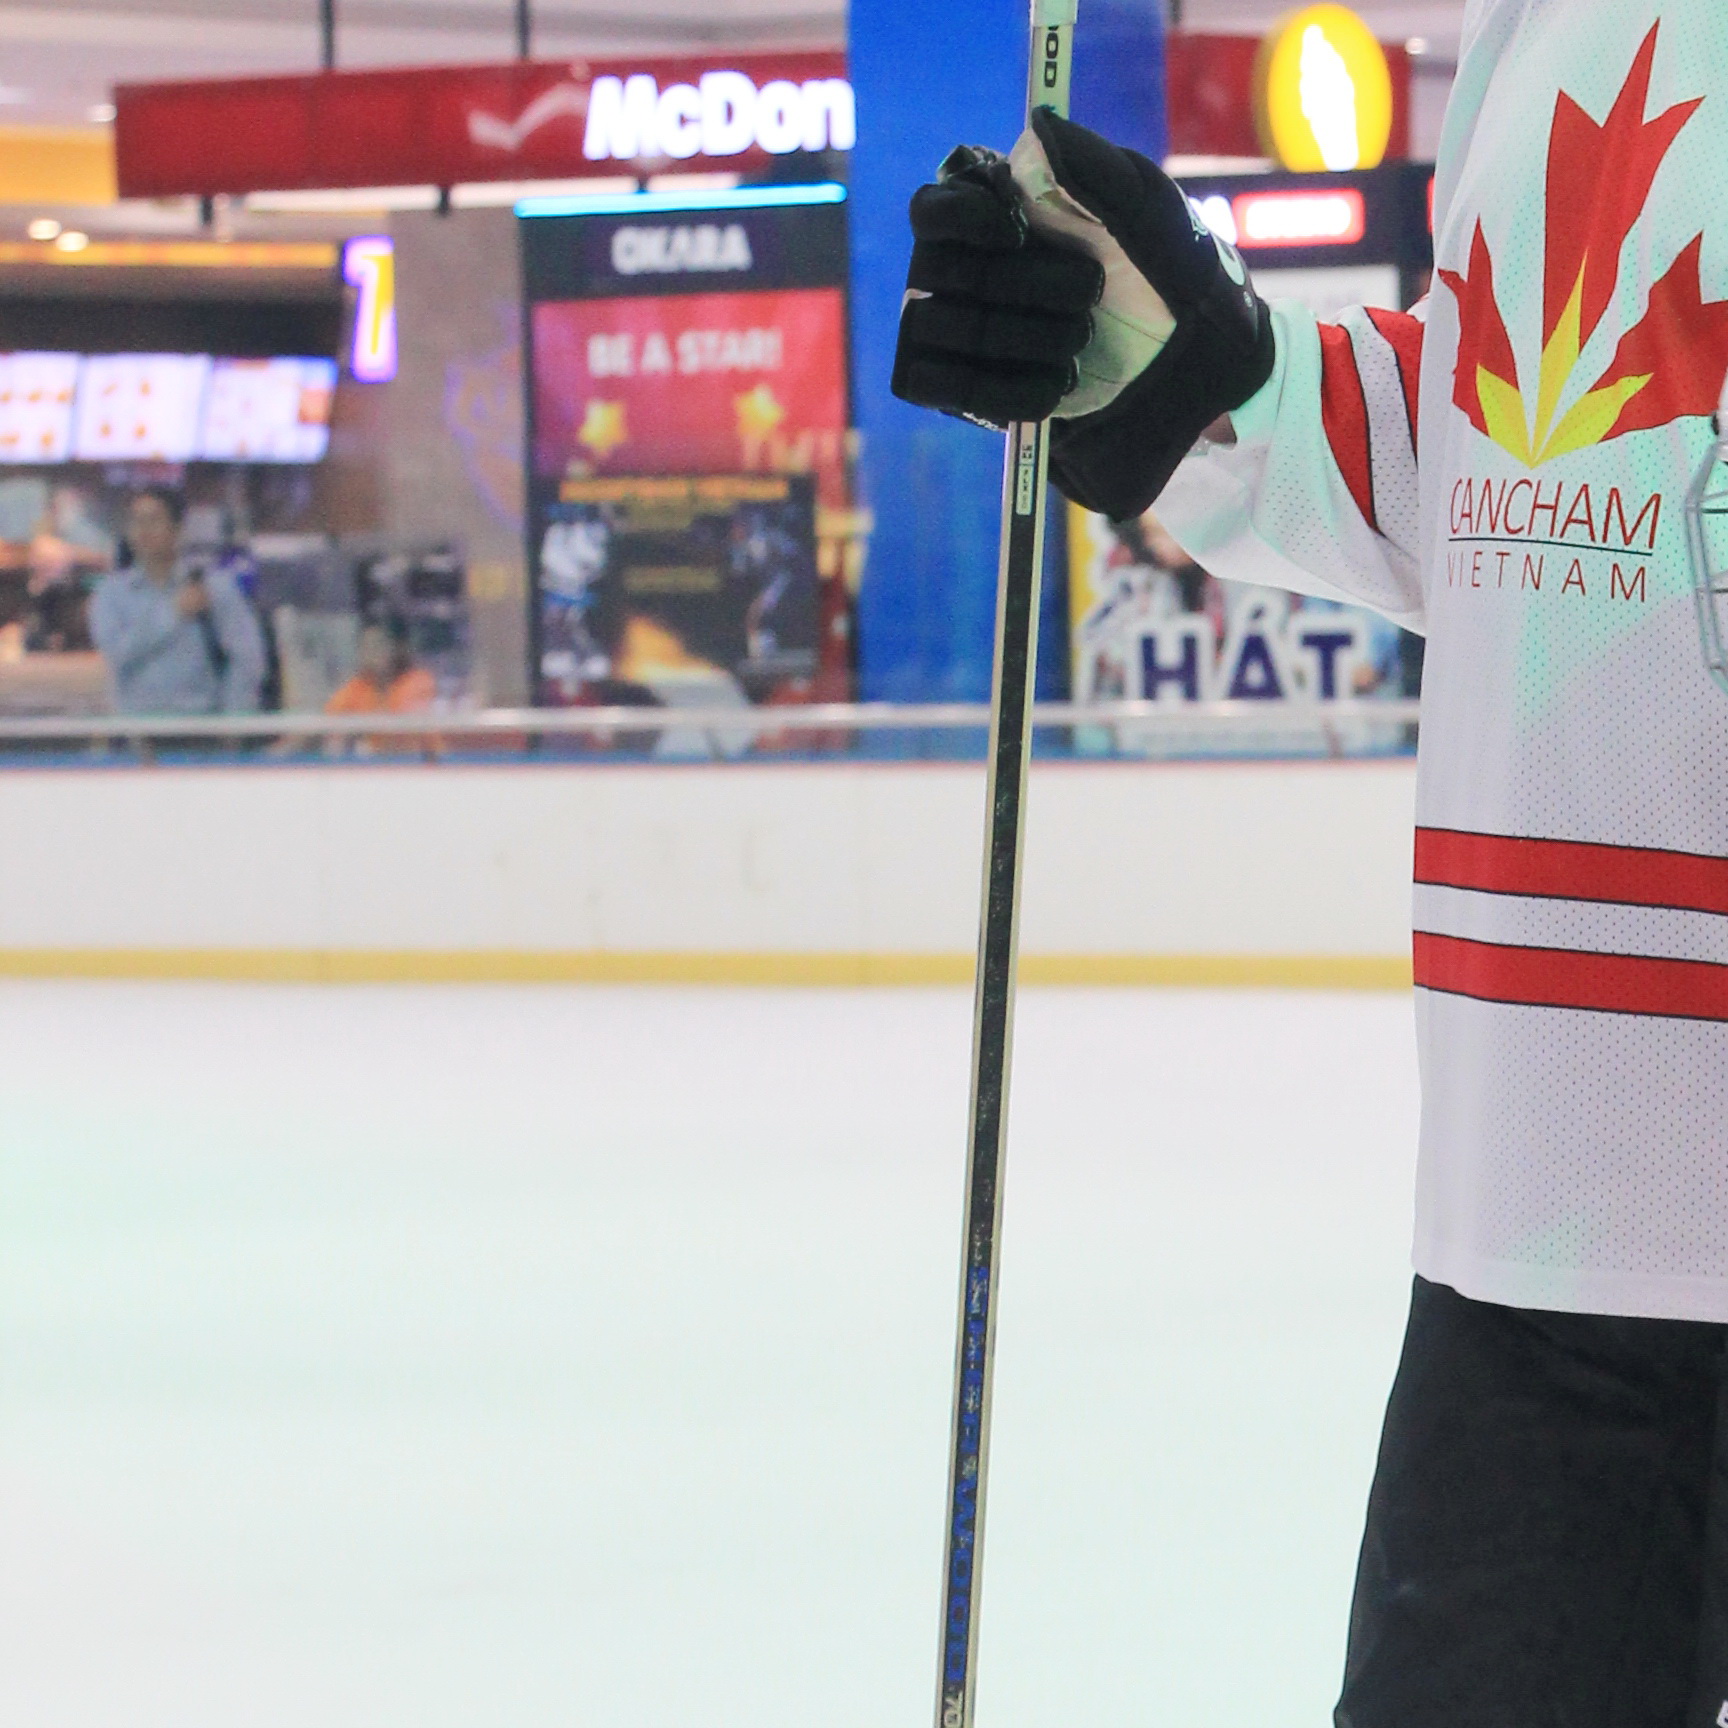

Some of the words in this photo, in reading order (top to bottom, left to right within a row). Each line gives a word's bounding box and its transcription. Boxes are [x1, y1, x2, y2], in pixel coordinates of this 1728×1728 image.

[1044, 25, 1060, 88] OD
[587, 333, 636, 377] BE
[640, 331, 672, 374] A
[1450, 477, 1663, 550] CANCHAM
[1447, 550, 1646, 603] VIETNAM
